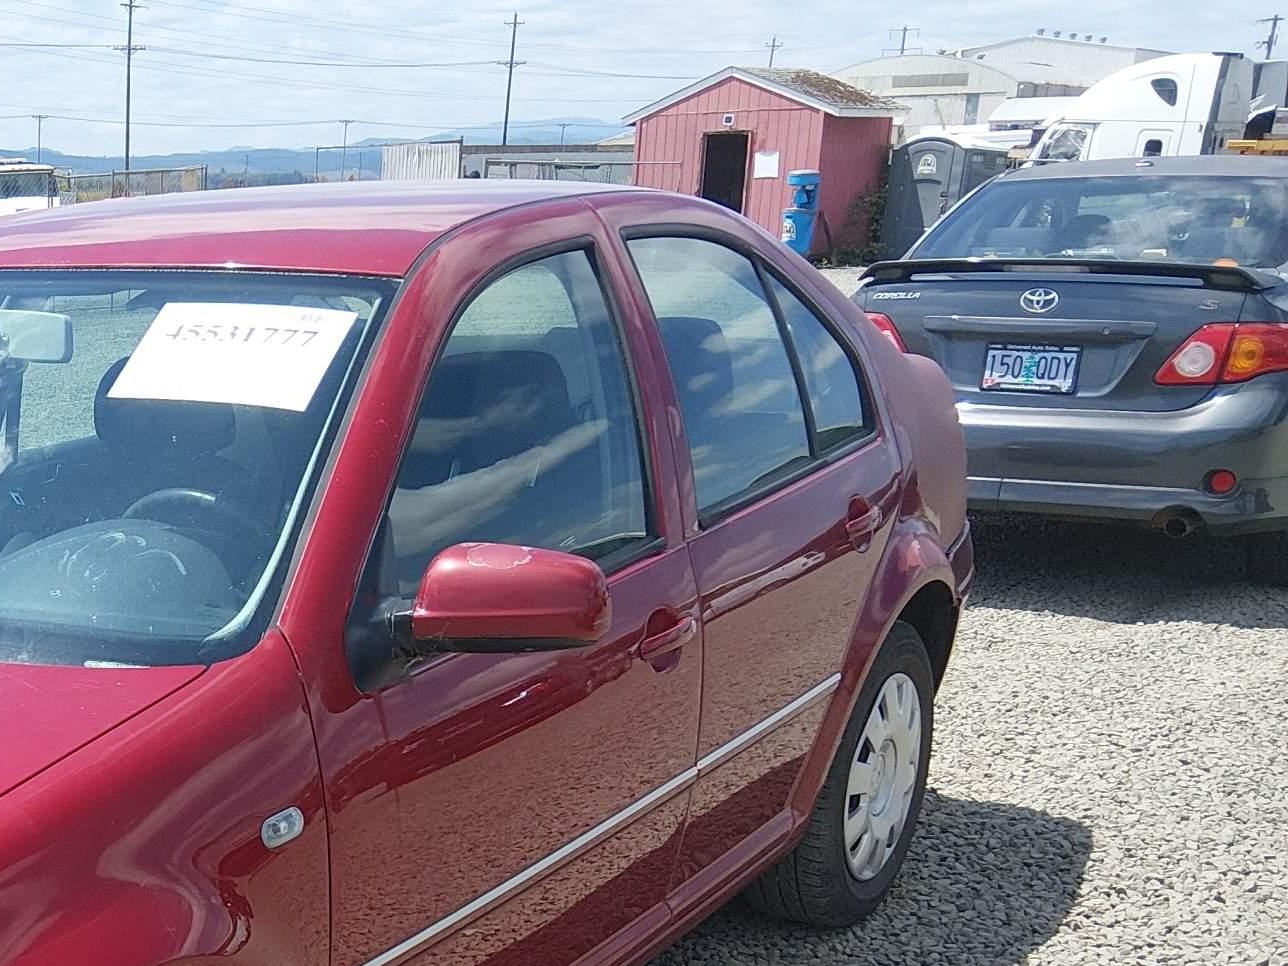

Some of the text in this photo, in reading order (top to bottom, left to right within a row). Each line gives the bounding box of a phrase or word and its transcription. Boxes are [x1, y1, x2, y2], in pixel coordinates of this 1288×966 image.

[873, 292, 921, 300] COROLLA
[988, 353, 1074, 381] 150 QDY
